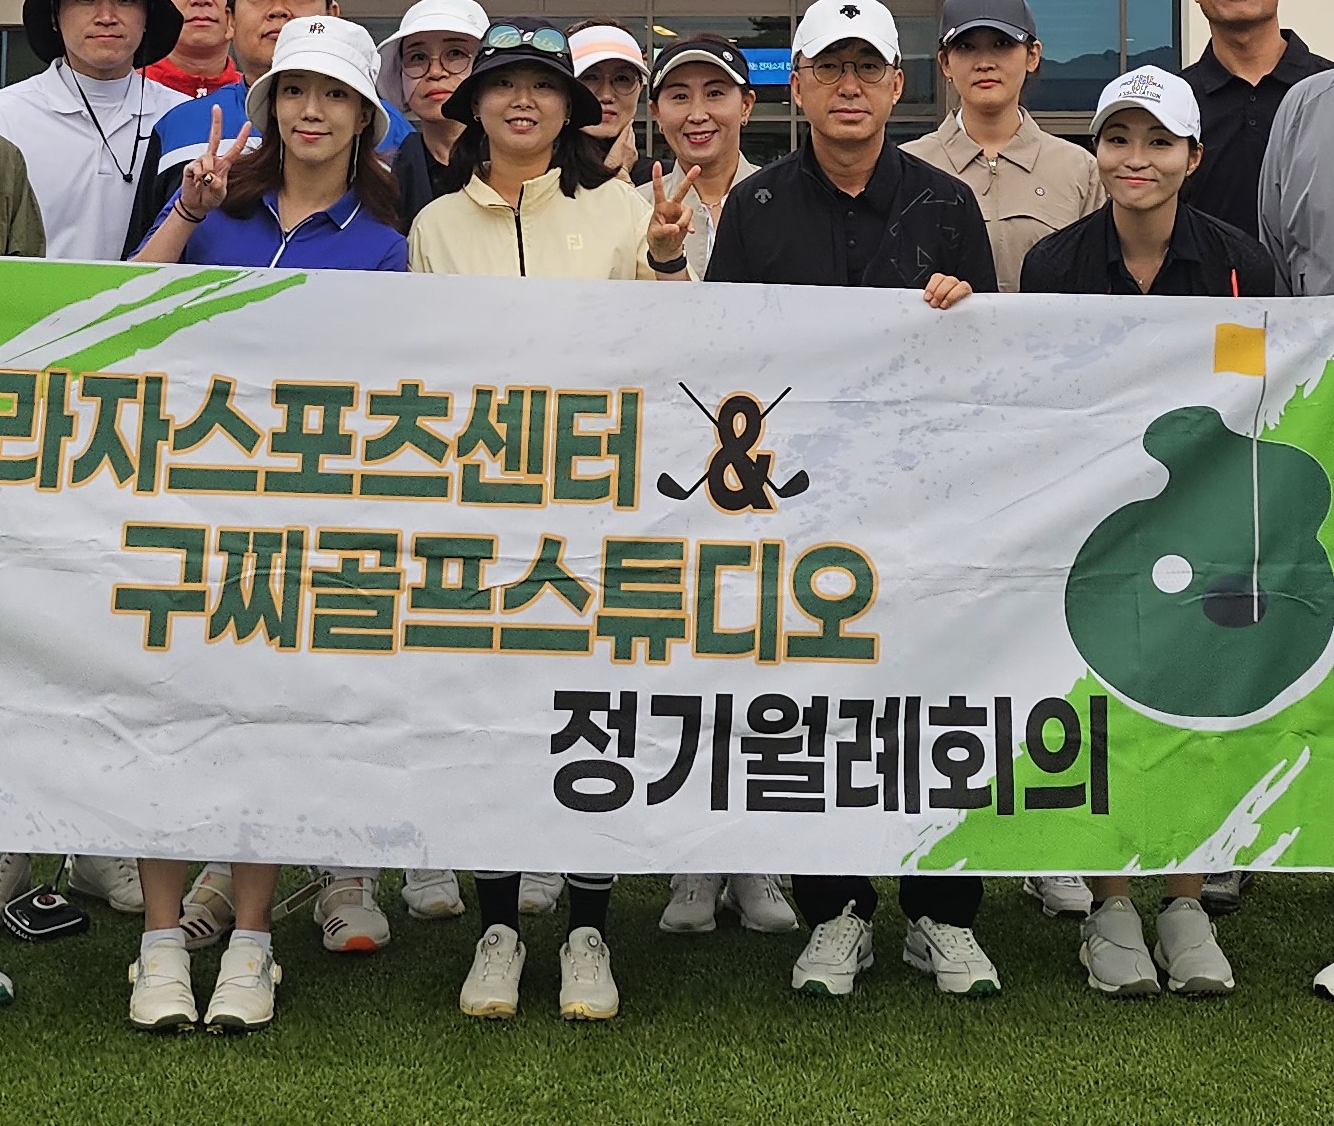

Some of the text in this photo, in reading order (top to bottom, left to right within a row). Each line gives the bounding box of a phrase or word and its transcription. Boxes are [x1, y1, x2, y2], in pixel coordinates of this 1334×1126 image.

[703, 390, 779, 514] &
[111, 521, 880, 665] 구찌골프스튜디오
[549, 690, 1110, 816] 정기월례회의
